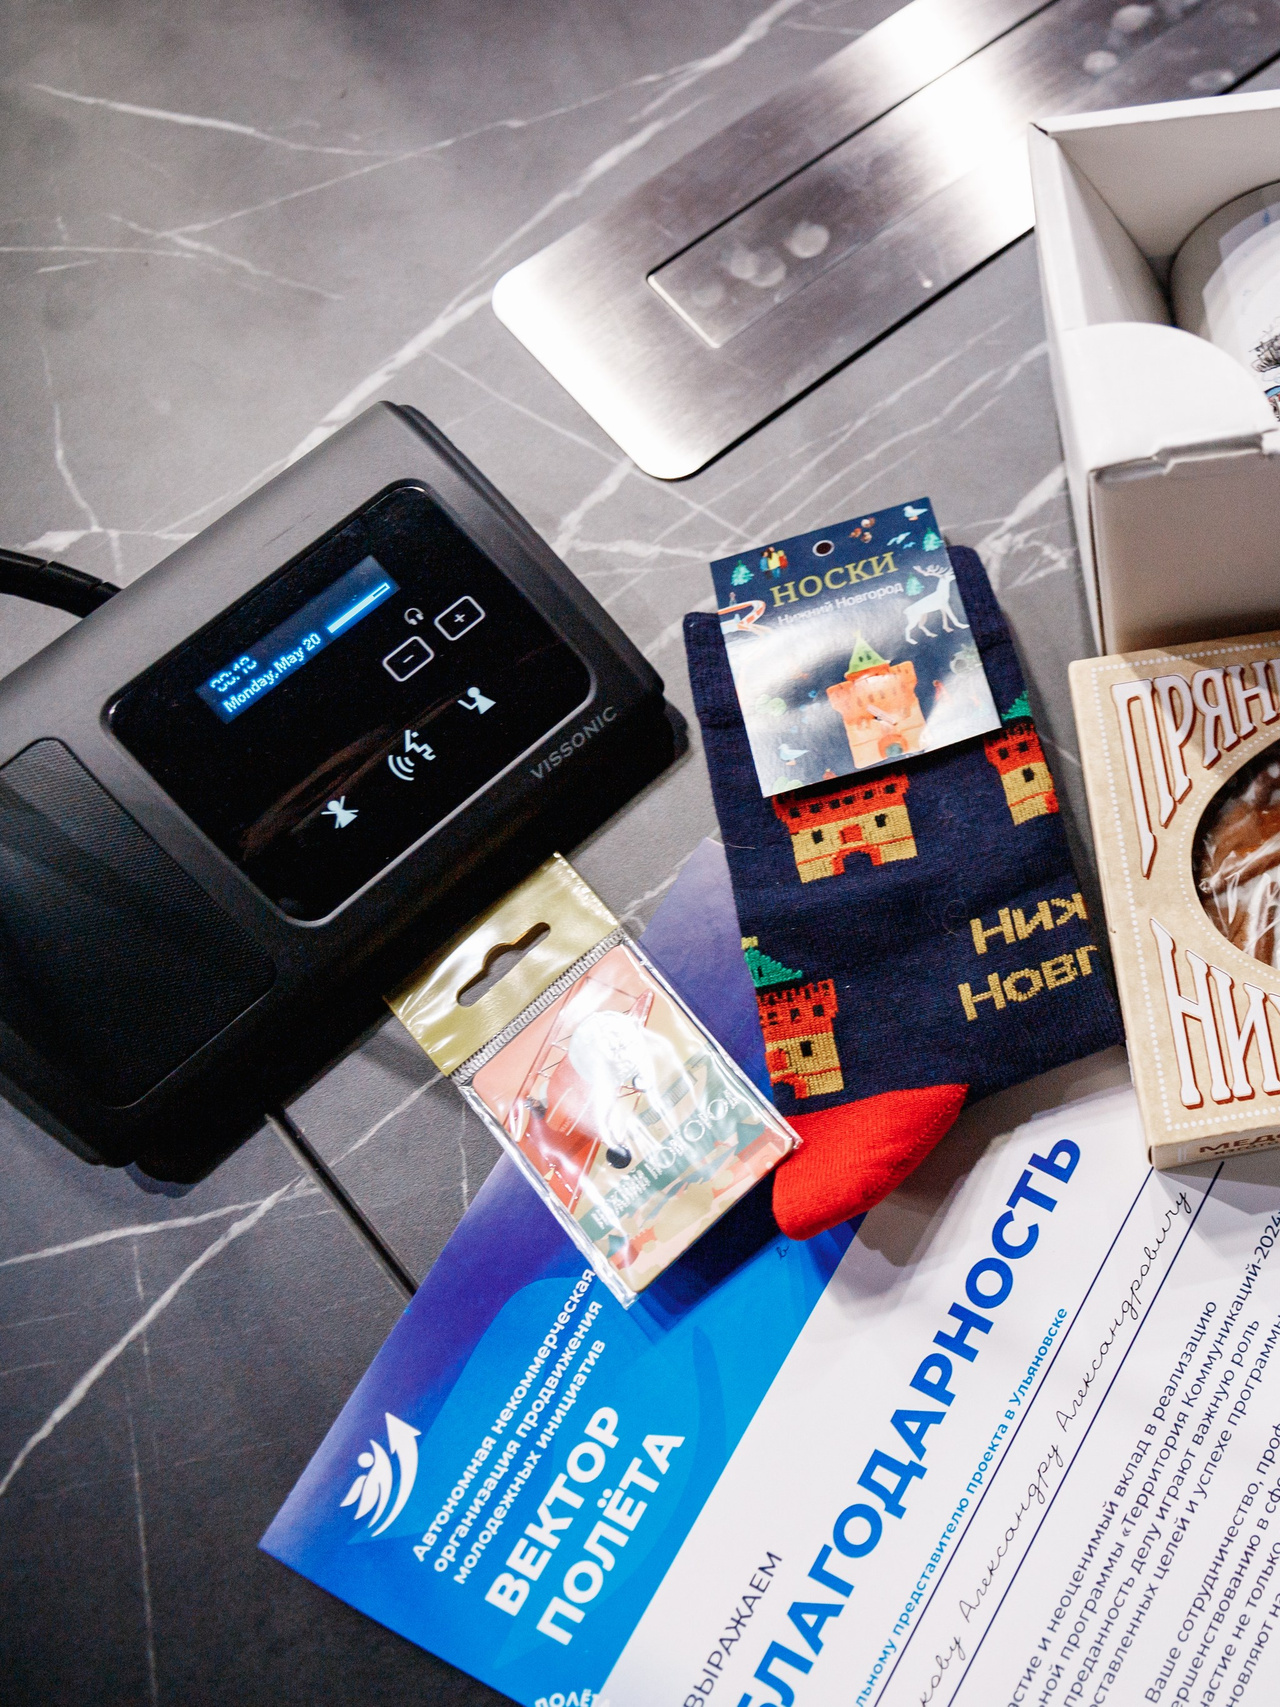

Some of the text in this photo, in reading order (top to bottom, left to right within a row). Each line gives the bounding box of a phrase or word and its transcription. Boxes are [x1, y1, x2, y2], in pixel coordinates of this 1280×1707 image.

[302, 632, 321, 651] 20
[770, 552, 898, 607] НОСКИ
[778, 583, 904, 624] Нижний Новгород
[530, 706, 617, 779] VISSONIC
[591, 1167, 650, 1229] НЖНИЙ
[413, 1268, 596, 1561] Автономная некоммерческая
[1005, 1410, 1015, 1420] в
[1009, 1309, 1067, 1406] Ульяновске
[435, 1302, 602, 1571] организация продвижения
[454, 1340, 605, 1584] молодежных инициатив
[485, 1407, 619, 1616] ВЕКТОР
[966, 1424, 1008, 1494] проекта
[1038, 1637, 1051, 1651] и
[1047, 1501, 1118, 1632] неоценимый
[1114, 1440, 1151, 1497] вклад
[1145, 1424, 1156, 1435] в
[1153, 1302, 1216, 1421] реализацию
[1154, 1518, 1189, 1579] целей
[1186, 1500, 1198, 1513] и
[1194, 1430, 1231, 1499] успехе
[537, 1435, 684, 1645] ПОЛЁТА
[893, 1498, 969, 1635] представителю
[960, 1445, 1063, 1622] Александру
[1061, 1542, 1124, 1659] программы
[1121, 1412, 1188, 1536] «Территория
[1064, 1321, 1259, 1707] преданность делу играют важную роль
[683, 1551, 782, 1707] ВЫРАЖАЕМ
[1145, 1648, 1180, 1703] Ваше
[1178, 1482, 1263, 1642] сотрудничество,
[1171, 1535, 1260, 1707] ершенствованию
[1257, 1518, 1268, 1530] в
[1226, 1621, 1272, 1707] новляют
[1232, 1614, 1250, 1639] не
